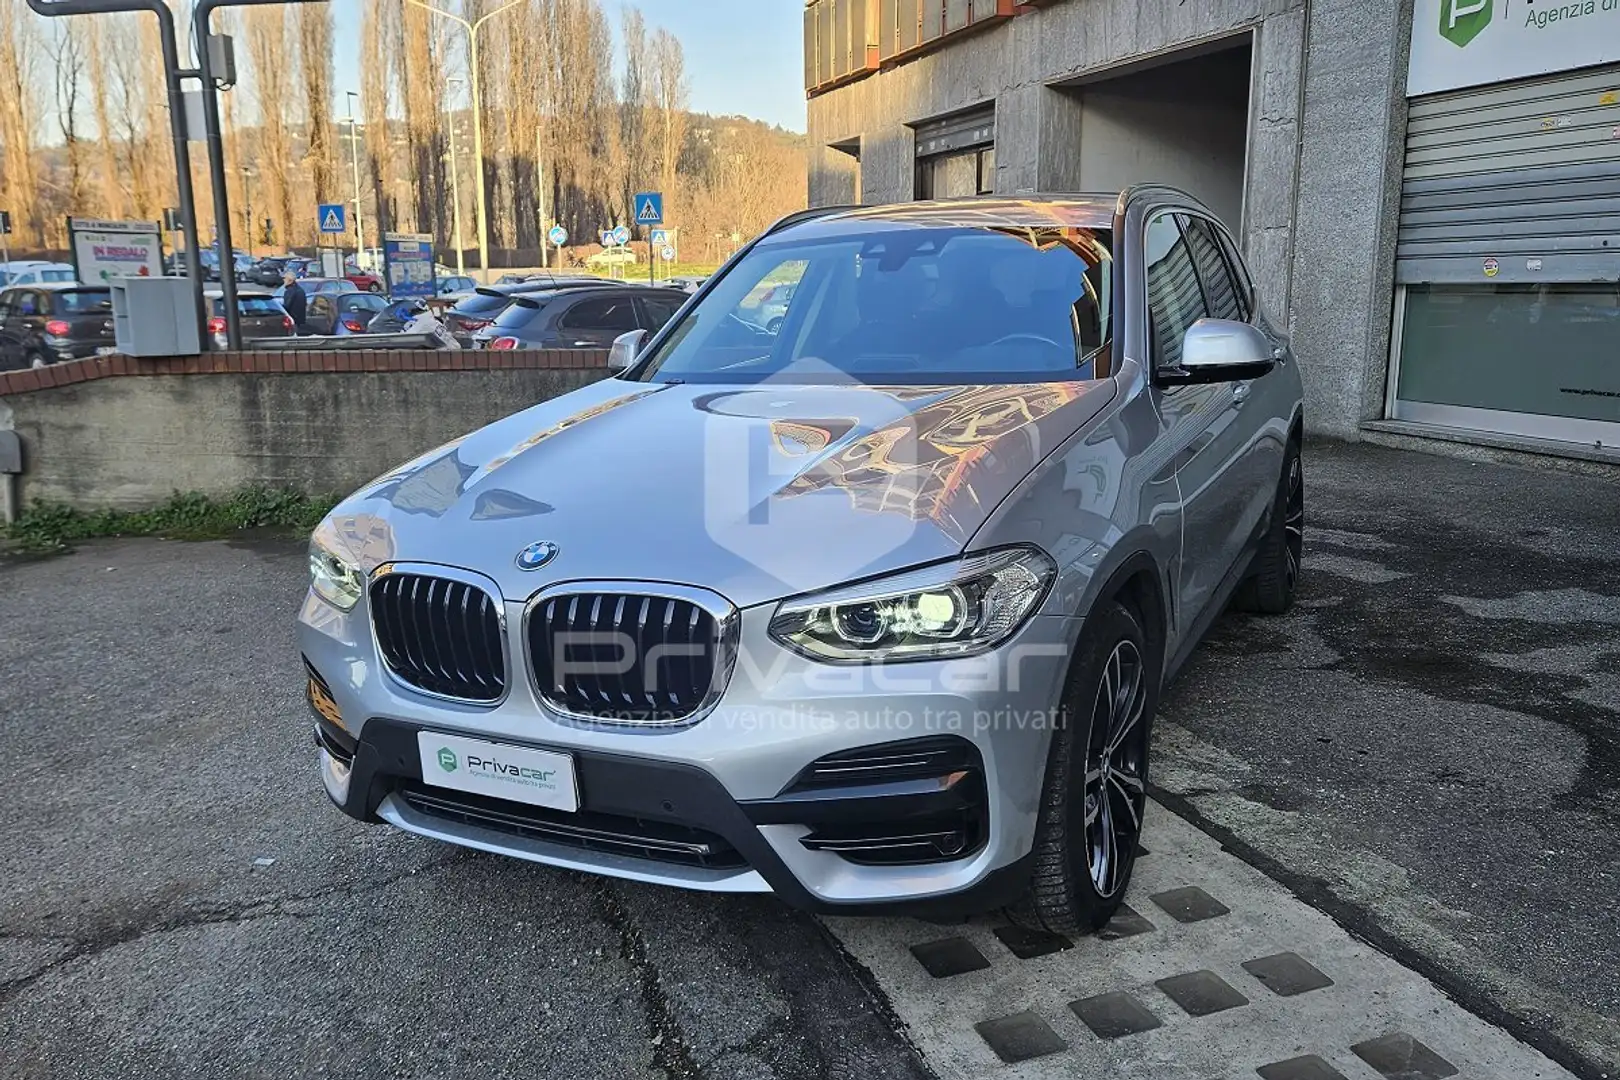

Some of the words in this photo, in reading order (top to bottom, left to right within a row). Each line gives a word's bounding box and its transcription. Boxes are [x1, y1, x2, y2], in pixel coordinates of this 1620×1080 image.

[1525, 1, 1595, 29] Agenzia
[93, 245, 104, 255] IN
[107, 246, 149, 257] REGALO
[467, 755, 556, 782] Privacar
